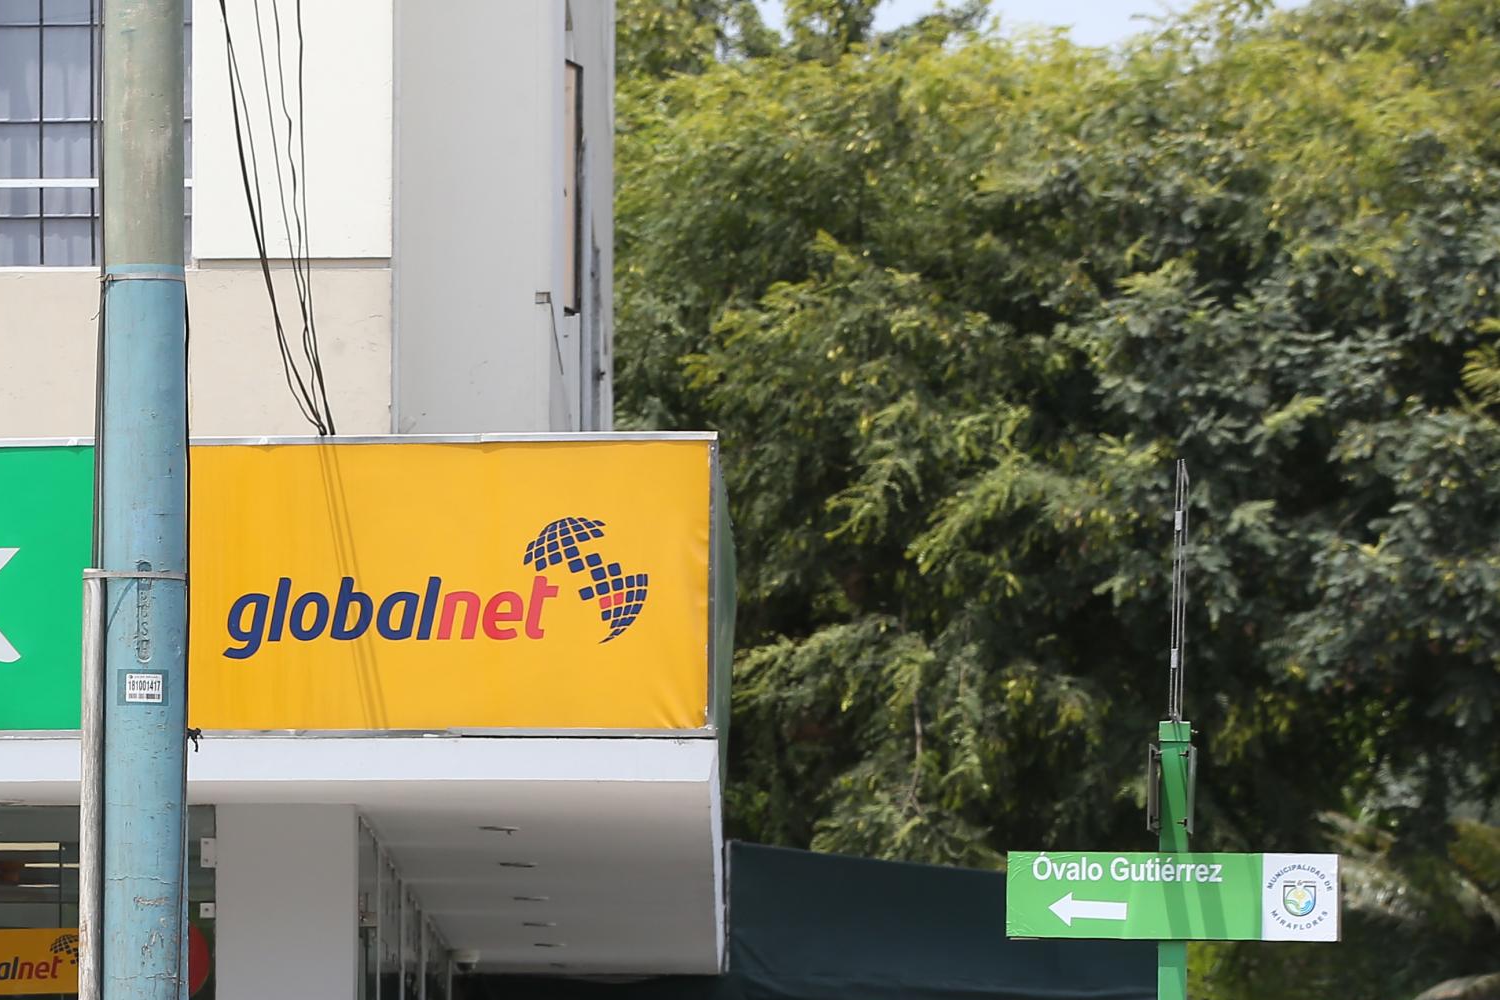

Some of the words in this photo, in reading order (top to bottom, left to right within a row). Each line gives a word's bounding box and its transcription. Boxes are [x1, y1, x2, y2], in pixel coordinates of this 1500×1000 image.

[222, 575, 559, 660] globalnet
[128, 680, 161, 691] 181001417
[1032, 852, 1103, 881] Óvalo
[1110, 857, 1223, 882] Gutiérrez
[1266, 864, 1326, 890] MUNICIPALIDAD
[1324, 880, 1333, 892] DE
[1270, 909, 1329, 931] MIRAFLORES
